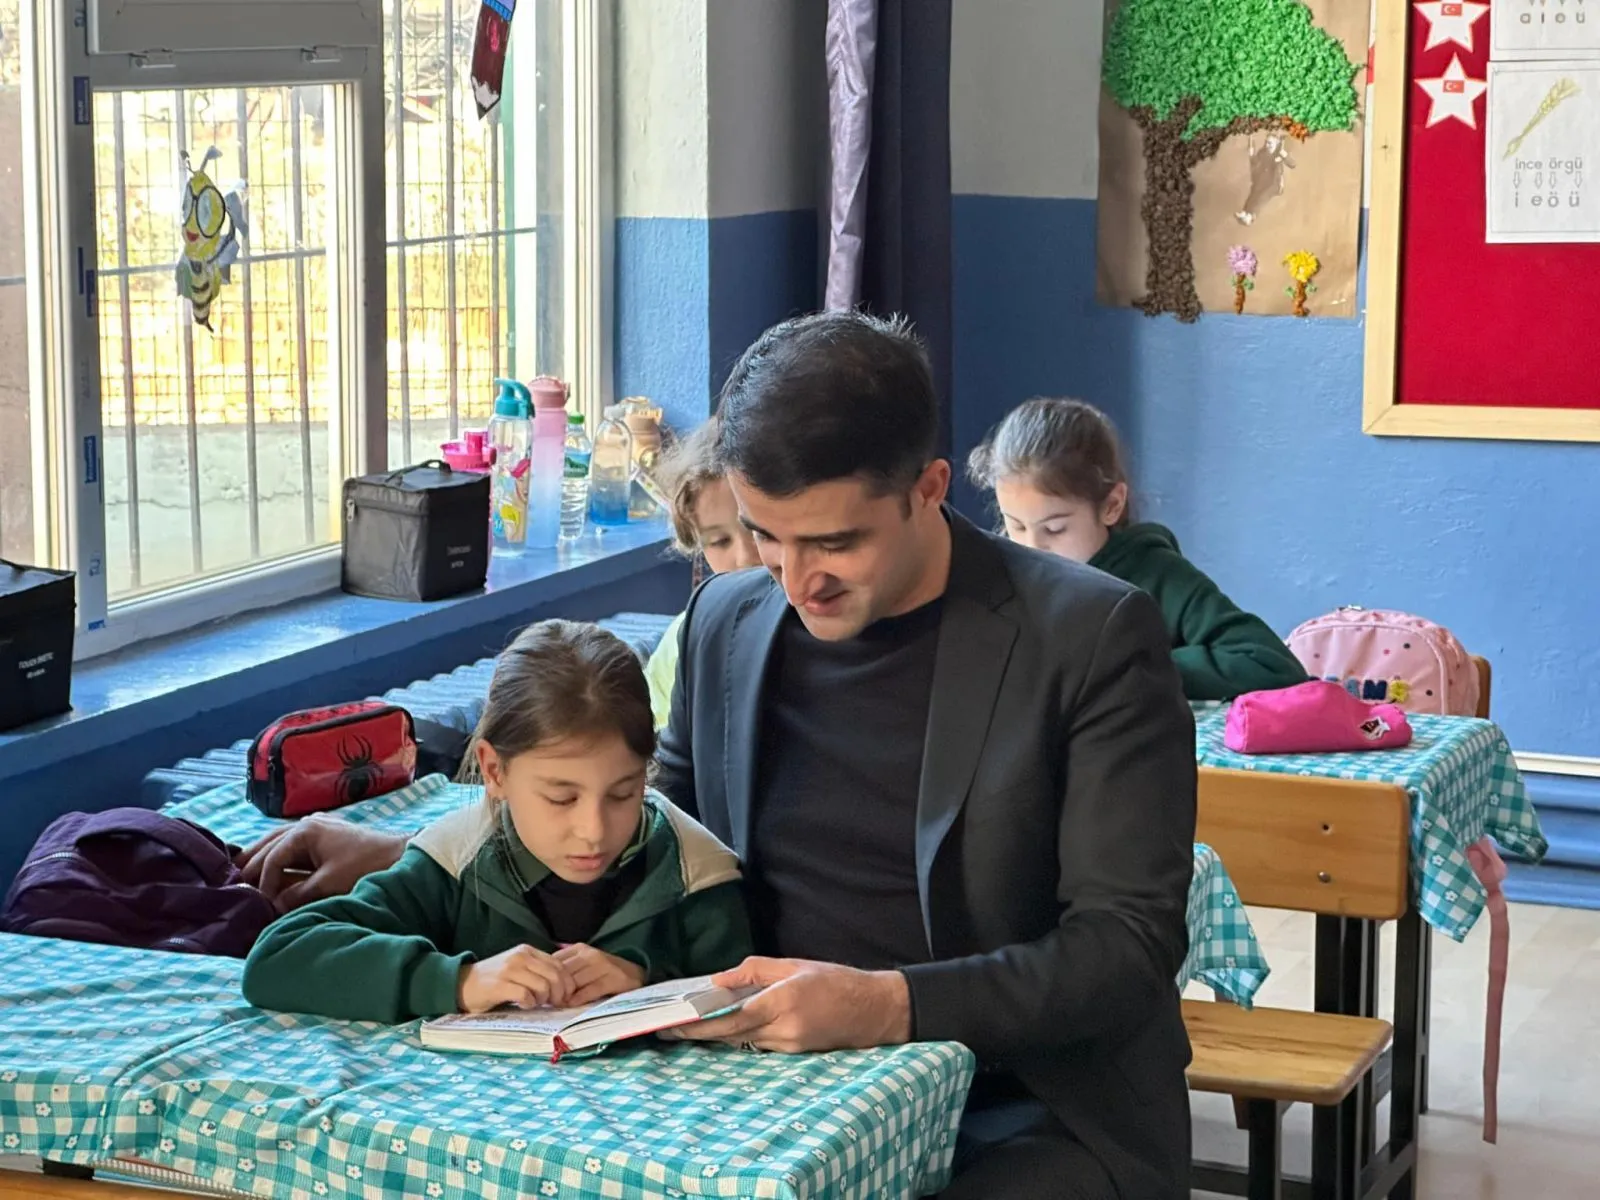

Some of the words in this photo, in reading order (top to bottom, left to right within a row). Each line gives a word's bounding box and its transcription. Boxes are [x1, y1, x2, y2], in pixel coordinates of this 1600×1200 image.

[1555, 12, 1566, 24] o
[1515, 157, 1543, 170] ince
[1549, 156, 1583, 175] örgü
[1531, 195, 1543, 207] e
[1547, 191, 1560, 208] ö
[1568, 190, 1580, 208] ü
